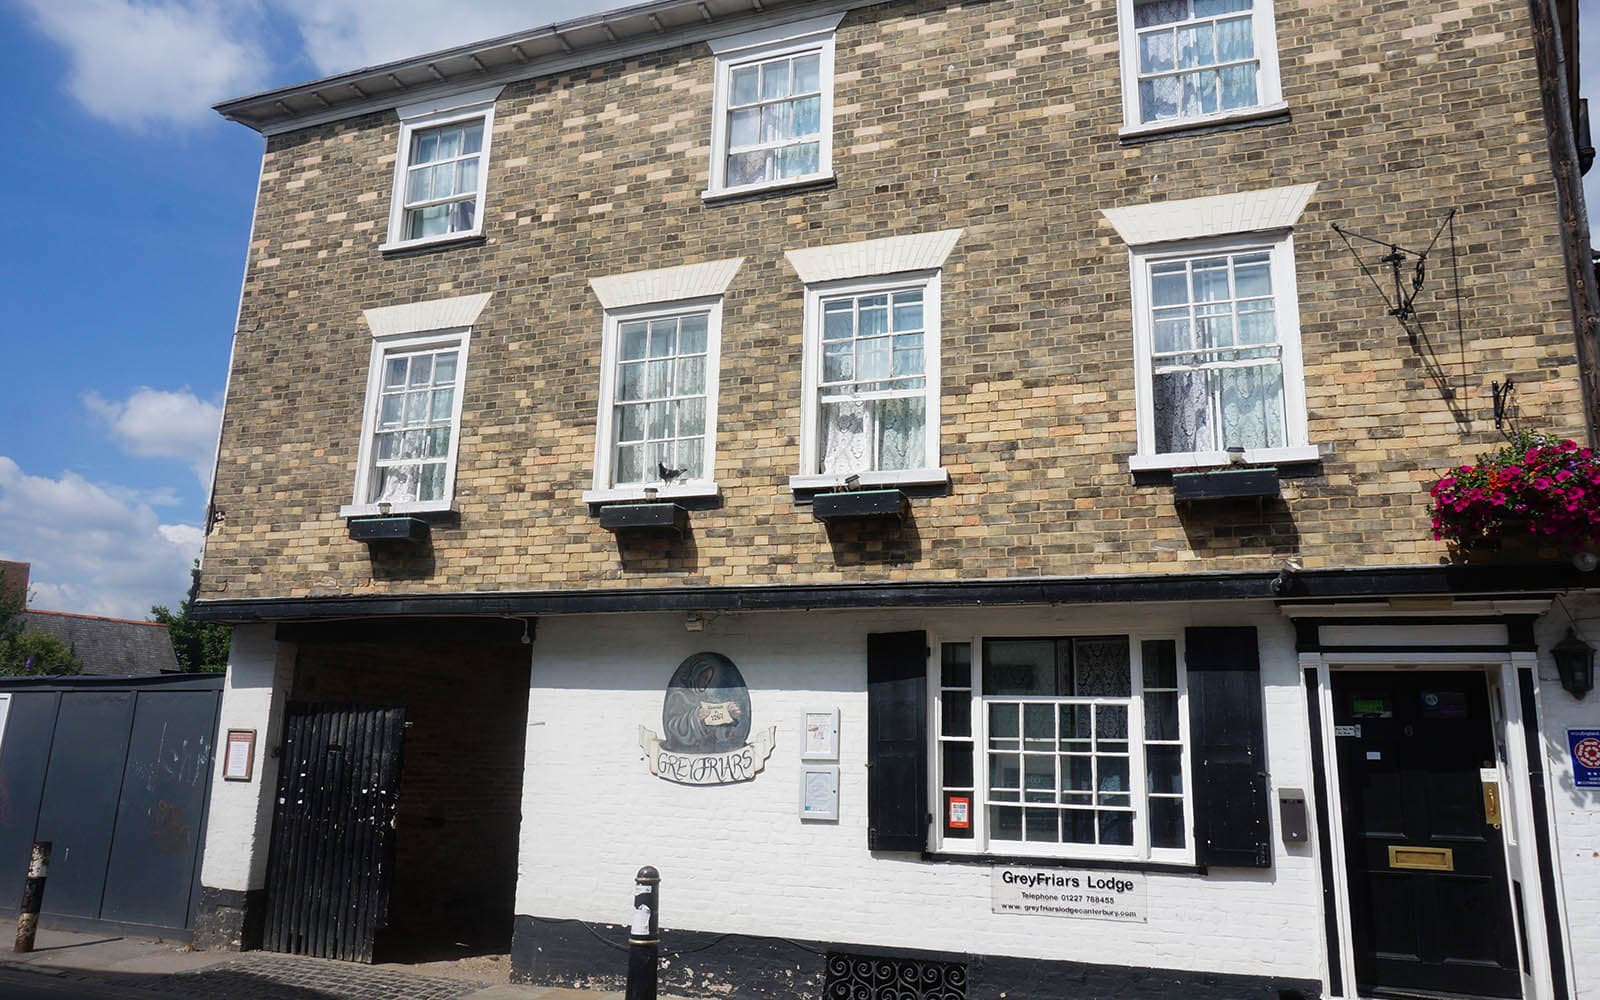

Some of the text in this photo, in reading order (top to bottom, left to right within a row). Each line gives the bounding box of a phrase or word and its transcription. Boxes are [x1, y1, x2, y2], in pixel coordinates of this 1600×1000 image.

[657, 749, 753, 783] GREYFRIARS
[1002, 870, 1134, 893] GreyFriars Lodge
[1022, 892, 1058, 901] Telephone
[1061, 894, 1083, 902] 01227
